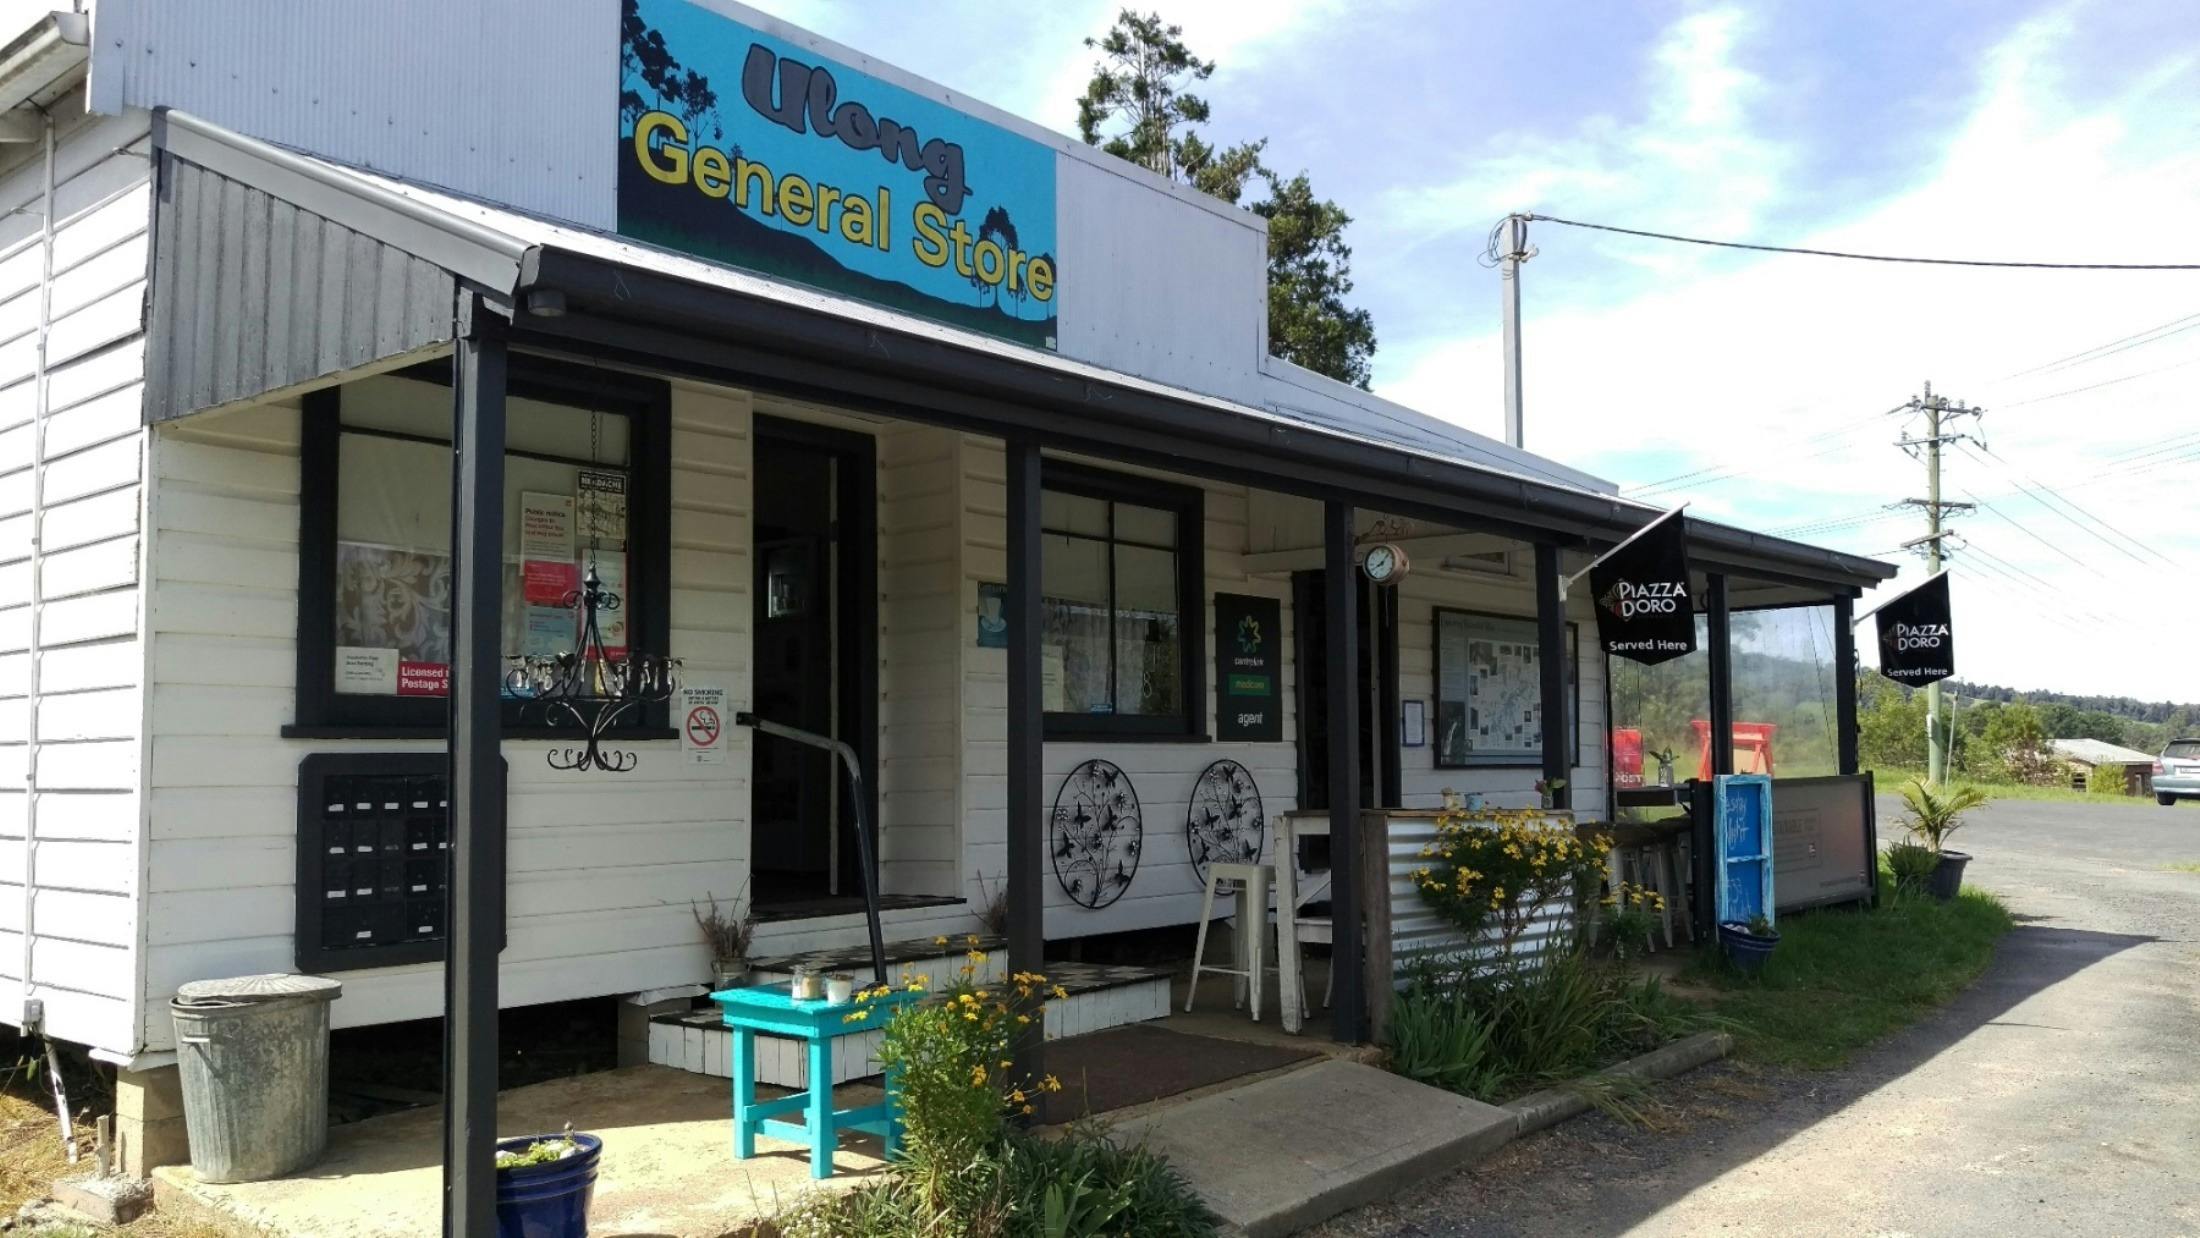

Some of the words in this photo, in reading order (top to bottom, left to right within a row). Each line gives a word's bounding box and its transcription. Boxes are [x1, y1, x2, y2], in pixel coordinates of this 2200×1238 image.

[742, 43, 973, 215] Ulong
[634, 110, 891, 251] General
[912, 201, 1056, 302] Store
[1619, 581, 1687, 599] PIAZZA
[1897, 623, 1949, 637] PIAZZA
[1609, 639, 1653, 651] Served
[1657, 640, 1688, 651] Here
[402, 666, 443, 677] Licensed
[1887, 667, 1921, 677] Served
[1924, 667, 1948, 676] Here
[402, 678, 439, 690] Postage
[1237, 711, 1264, 727] agent
